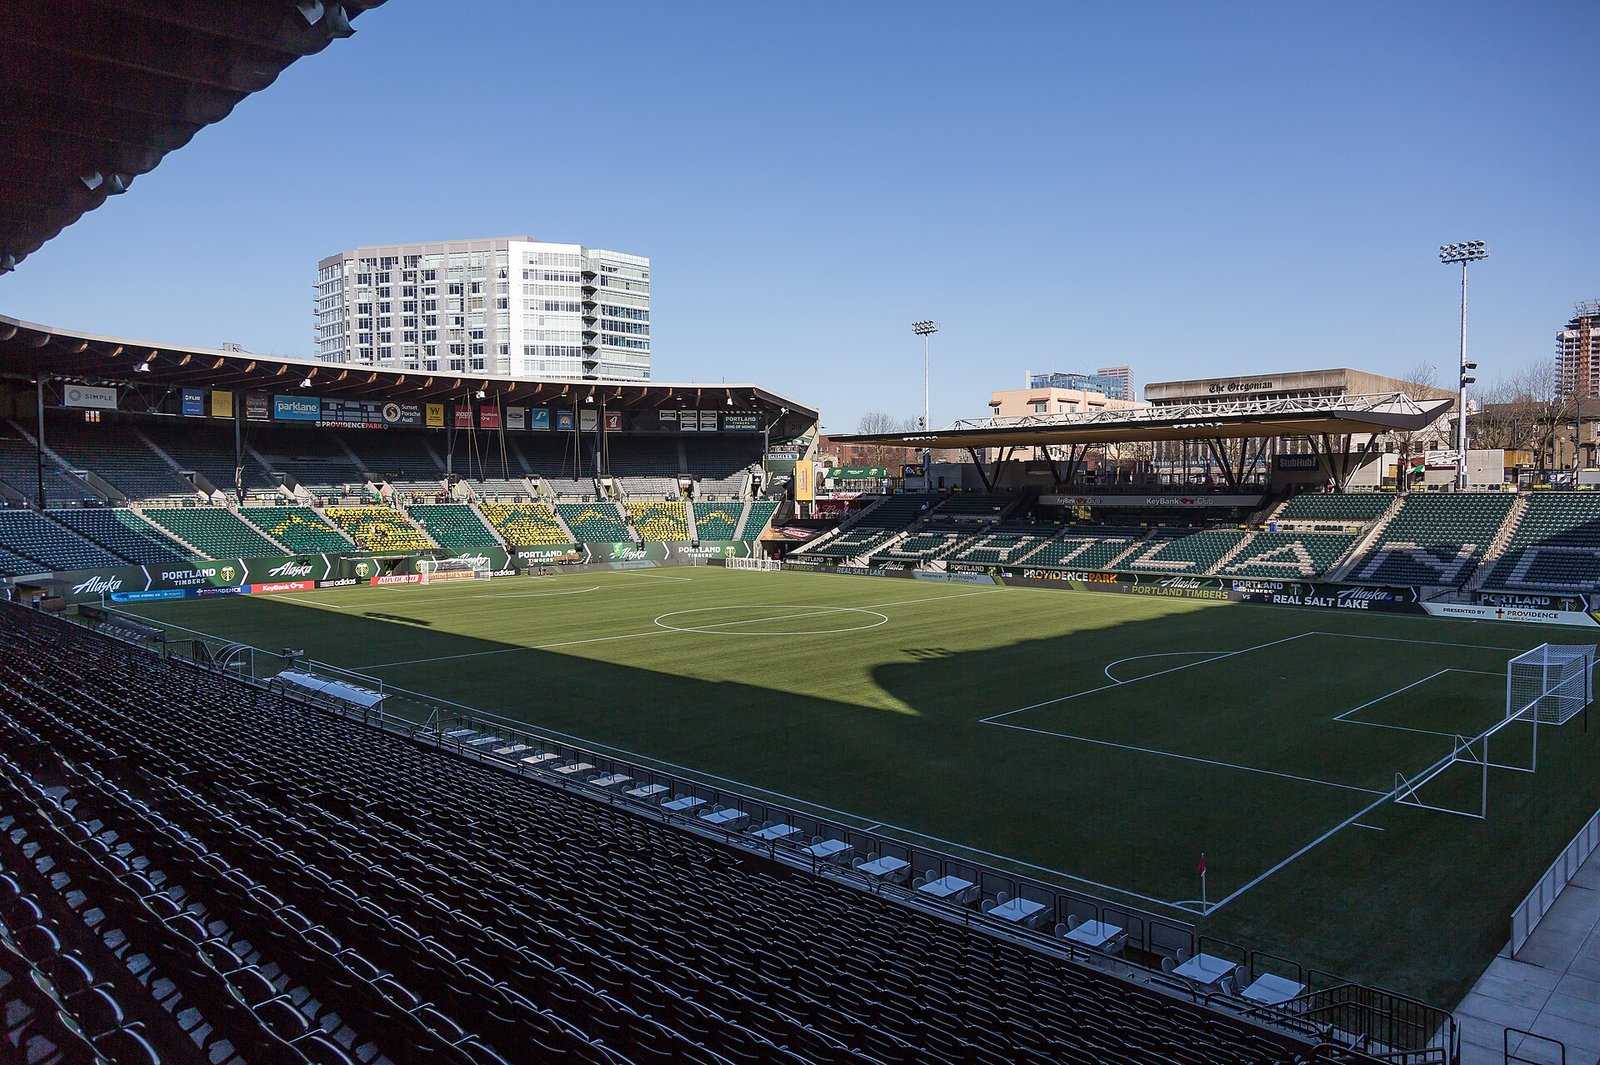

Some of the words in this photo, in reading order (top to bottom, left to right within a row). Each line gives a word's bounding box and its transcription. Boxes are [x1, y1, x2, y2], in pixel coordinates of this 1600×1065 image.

[1209, 383, 1225, 394] The
[1227, 381, 1273, 392] Oregonian
[85, 393, 113, 401] SIMPLE
[1279, 456, 1317, 468] StubHub!
[1146, 497, 1179, 506] KeyBank
[1197, 497, 1214, 505] Club
[518, 550, 562, 559] PORTLAND
[268, 561, 313, 577] Alaska
[869, 569, 887, 577] LAKE
[950, 564, 985, 573] PORTLAND
[161, 568, 216, 581] PORTLAND
[72, 575, 123, 594] Alaska
[174, 578, 206, 586] TIMBERS
[334, 577, 357, 586] adidas
[1160, 576, 1201, 588] Alaska
[1233, 580, 1284, 590] PORTLAND
[203, 587, 242, 595] PROVIDENCE
[263, 584, 289, 592] KeyBank
[1132, 586, 1183, 596] PORTLAND
[1185, 589, 1229, 600] TIMBERS
[1337, 586, 1389, 600] Alaska
[1273, 595, 1302, 604] REAL
[1304, 596, 1336, 607] SALT
[1337, 598, 1370, 609] LAKE
[1443, 607, 1476, 615] PRESENTED
[1507, 610, 1559, 619] PROVIDENCE
